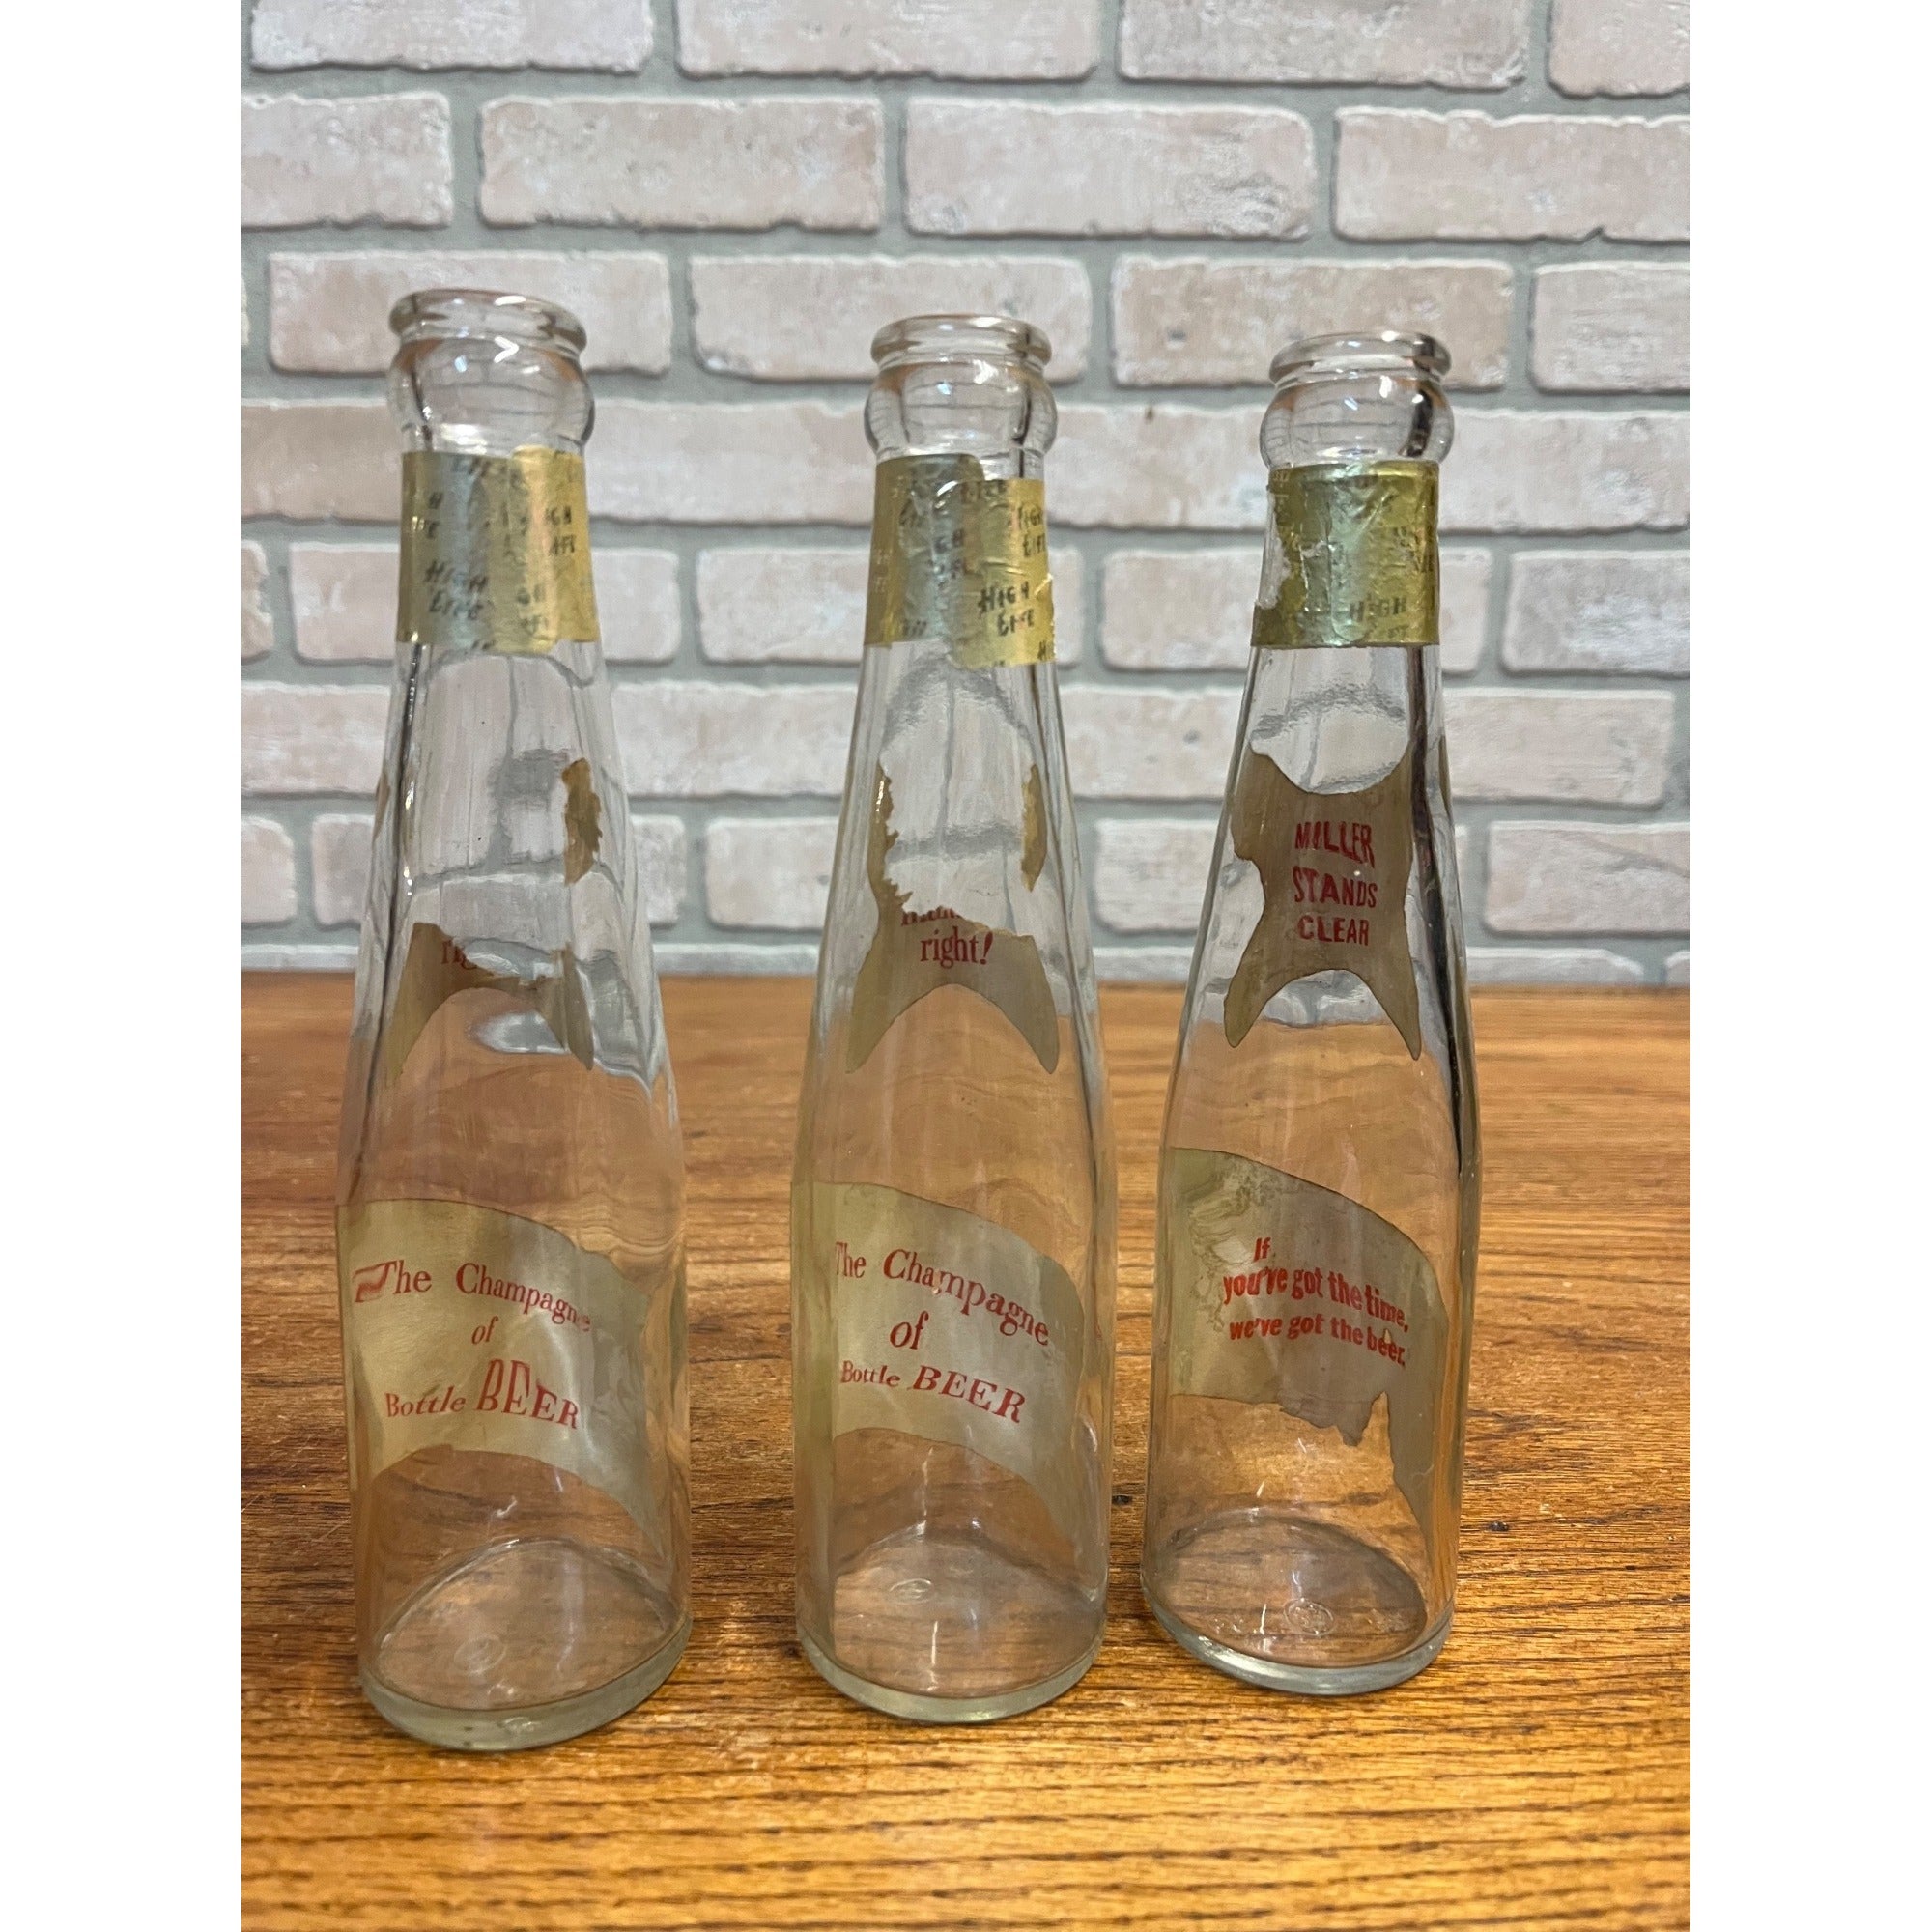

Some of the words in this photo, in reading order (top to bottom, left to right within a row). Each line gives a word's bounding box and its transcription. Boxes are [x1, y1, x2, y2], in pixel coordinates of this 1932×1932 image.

[1295, 820, 1375, 868] MILLER
[1293, 866, 1378, 908] STANDS
[920, 925, 994, 969] right!
[1297, 915, 1370, 946] CLEAR
[1253, 1237, 1271, 1262] If
[352, 1260, 432, 1303] The
[456, 1262, 592, 1332] Champagne
[836, 1241, 867, 1278] The
[883, 1248, 1050, 1347] Champagne
[1223, 1266, 1287, 1305] you've
[1292, 1266, 1324, 1300] got
[1328, 1270, 1362, 1311] the
[1365, 1284, 1409, 1332] time,
[471, 1316, 499, 1345] of
[889, 1310, 929, 1350] of
[1229, 1316, 1283, 1341] we've
[1288, 1313, 1325, 1340] got
[1330, 1318, 1364, 1346] the
[1367, 1330, 1406, 1368] beer.
[384, 1386, 467, 1418] Bottle
[476, 1358, 581, 1430] BEER
[840, 1360, 901, 1388] Bottle
[911, 1364, 1027, 1424] BEER
